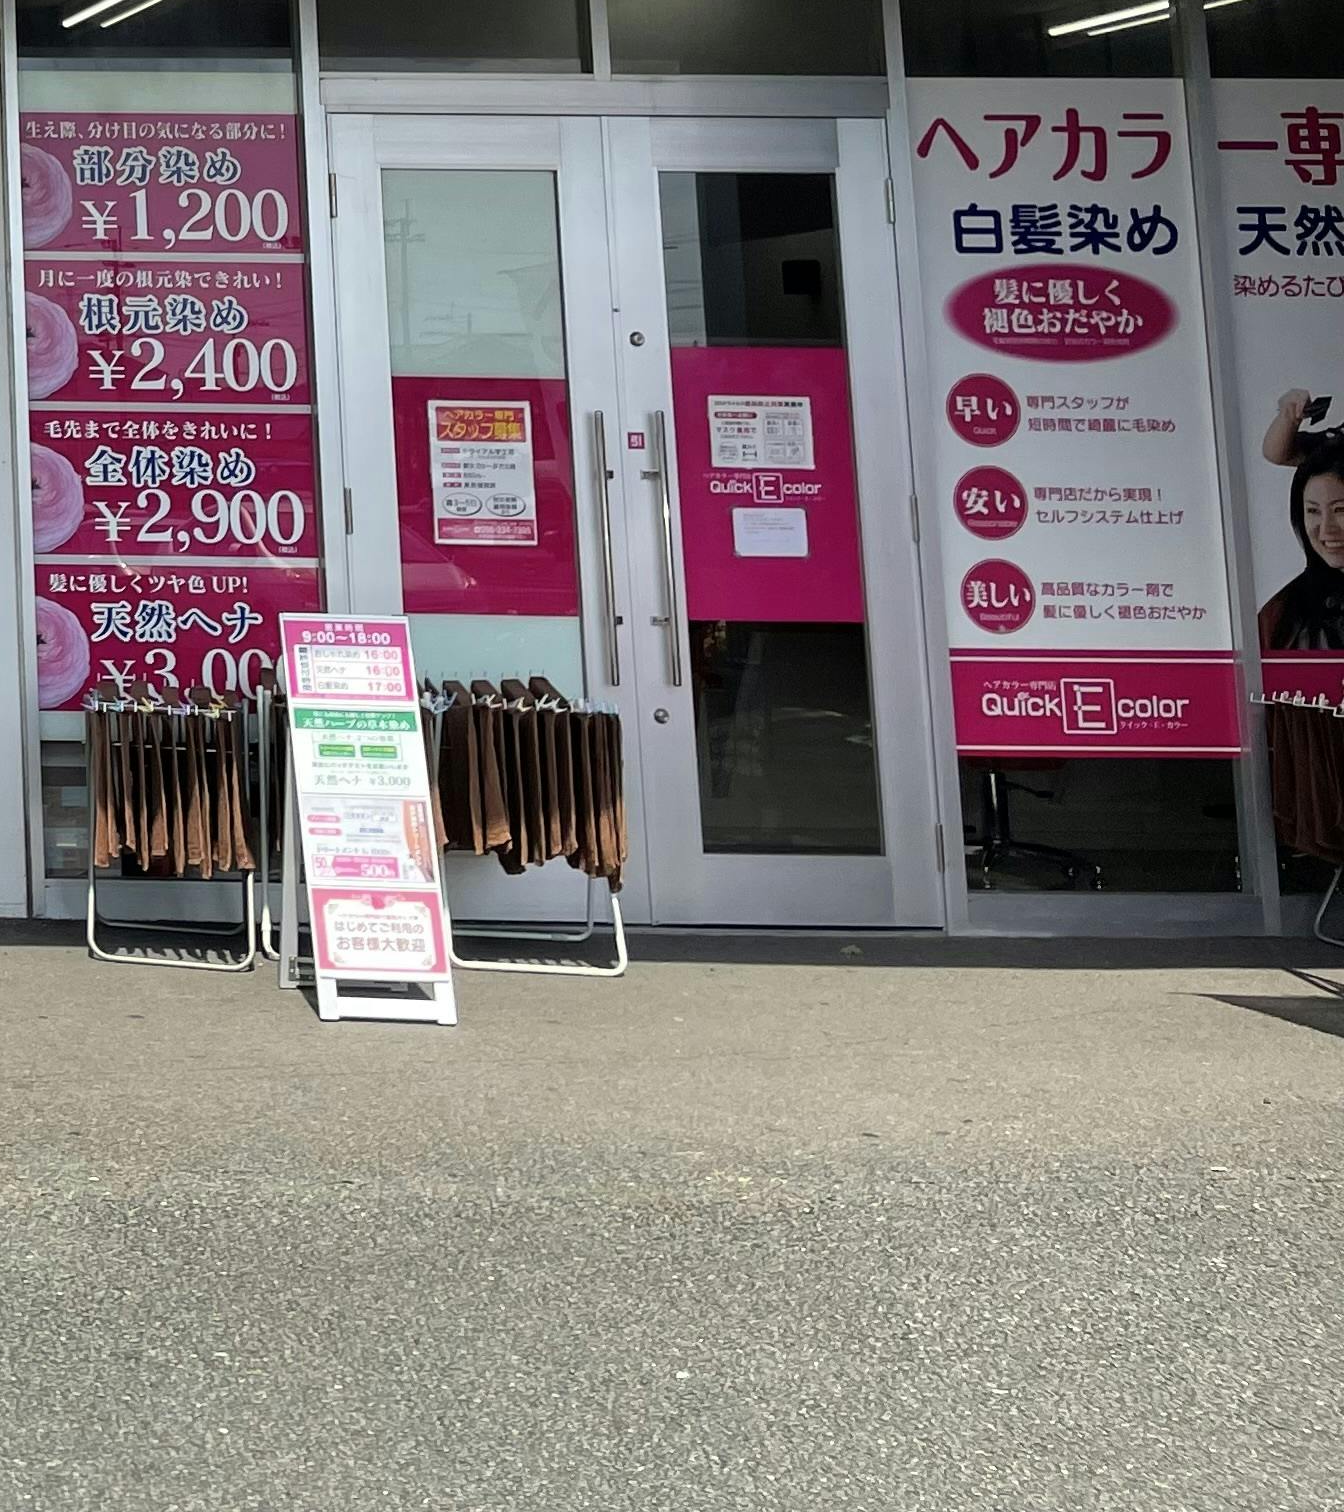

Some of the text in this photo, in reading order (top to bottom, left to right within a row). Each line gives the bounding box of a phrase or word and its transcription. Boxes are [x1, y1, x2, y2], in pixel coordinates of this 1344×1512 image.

[73, 145, 242, 187] 部分染め
[79, 188, 289, 250] ¥1,200
[952, 202, 1180, 256] 白髪染め
[1236, 204, 1344, 257] 天然
[992, 278, 1121, 306] 髪に優しく
[79, 293, 249, 336] 根元染め
[982, 307, 1144, 335] 褪色おだやか
[86, 338, 298, 400] ¥2,400
[954, 394, 1013, 423] 早い
[1026, 395, 1129, 410] 専門スタッフが
[438, 421, 523, 440] スタッフ募集
[1027, 417, 1177, 433] 短時間で綺麗に毛染め
[84, 445, 256, 488] 全体染め
[783, 482, 822, 495] color
[962, 486, 1021, 516] 安い
[1034, 487, 1162, 502] 専門店だから実現!
[92, 489, 305, 552] ¥2,900
[1036, 509, 1184, 525] セルフシステム仕上げ
[966, 580, 1031, 609] 美しい
[1041, 582, 1174, 597] 高品質なカラー剤で
[90, 600, 263, 643] 天然ヘナ
[1043, 604, 1207, 620] 髪に優しく褪色おだやか
[367, 682, 403, 693] 17:00
[982, 691, 1062, 718] Quick
[1117, 695, 1190, 719] color
[334, 921, 424, 935] はじめてご利用の
[335, 936, 426, 953] お客様大歓迎
